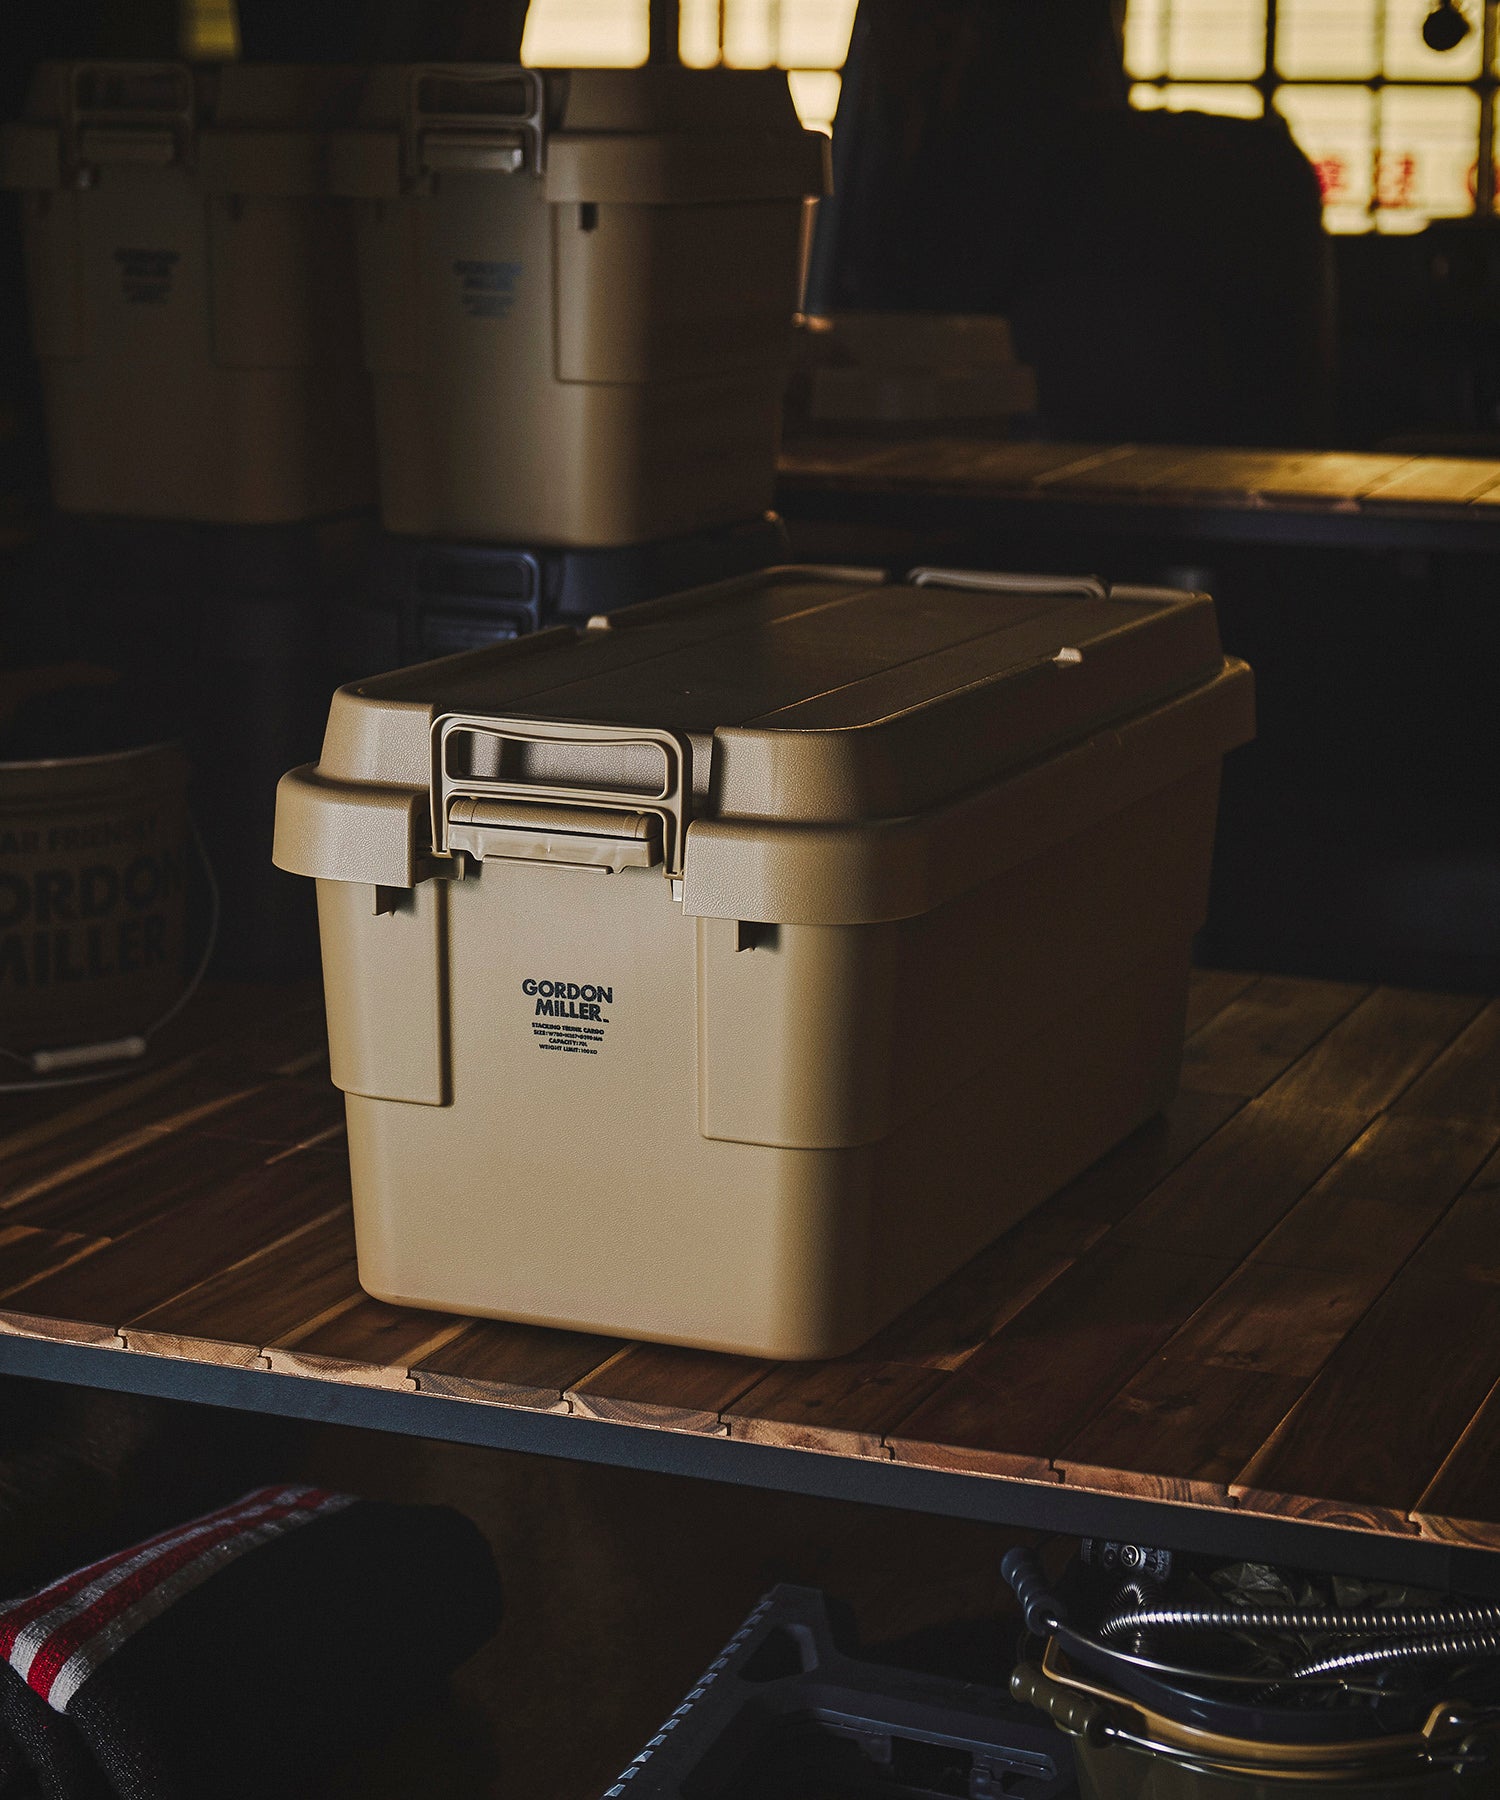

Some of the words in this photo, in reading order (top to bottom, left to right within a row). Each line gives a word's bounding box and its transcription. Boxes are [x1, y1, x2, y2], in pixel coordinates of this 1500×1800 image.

[522, 978, 613, 1004] GORDON
[535, 998, 602, 1022] MILLER
[532, 1022, 561, 1030] STACKING
[583, 1027, 605, 1035] CARGO
[538, 1043, 562, 1051] WEIGHT
